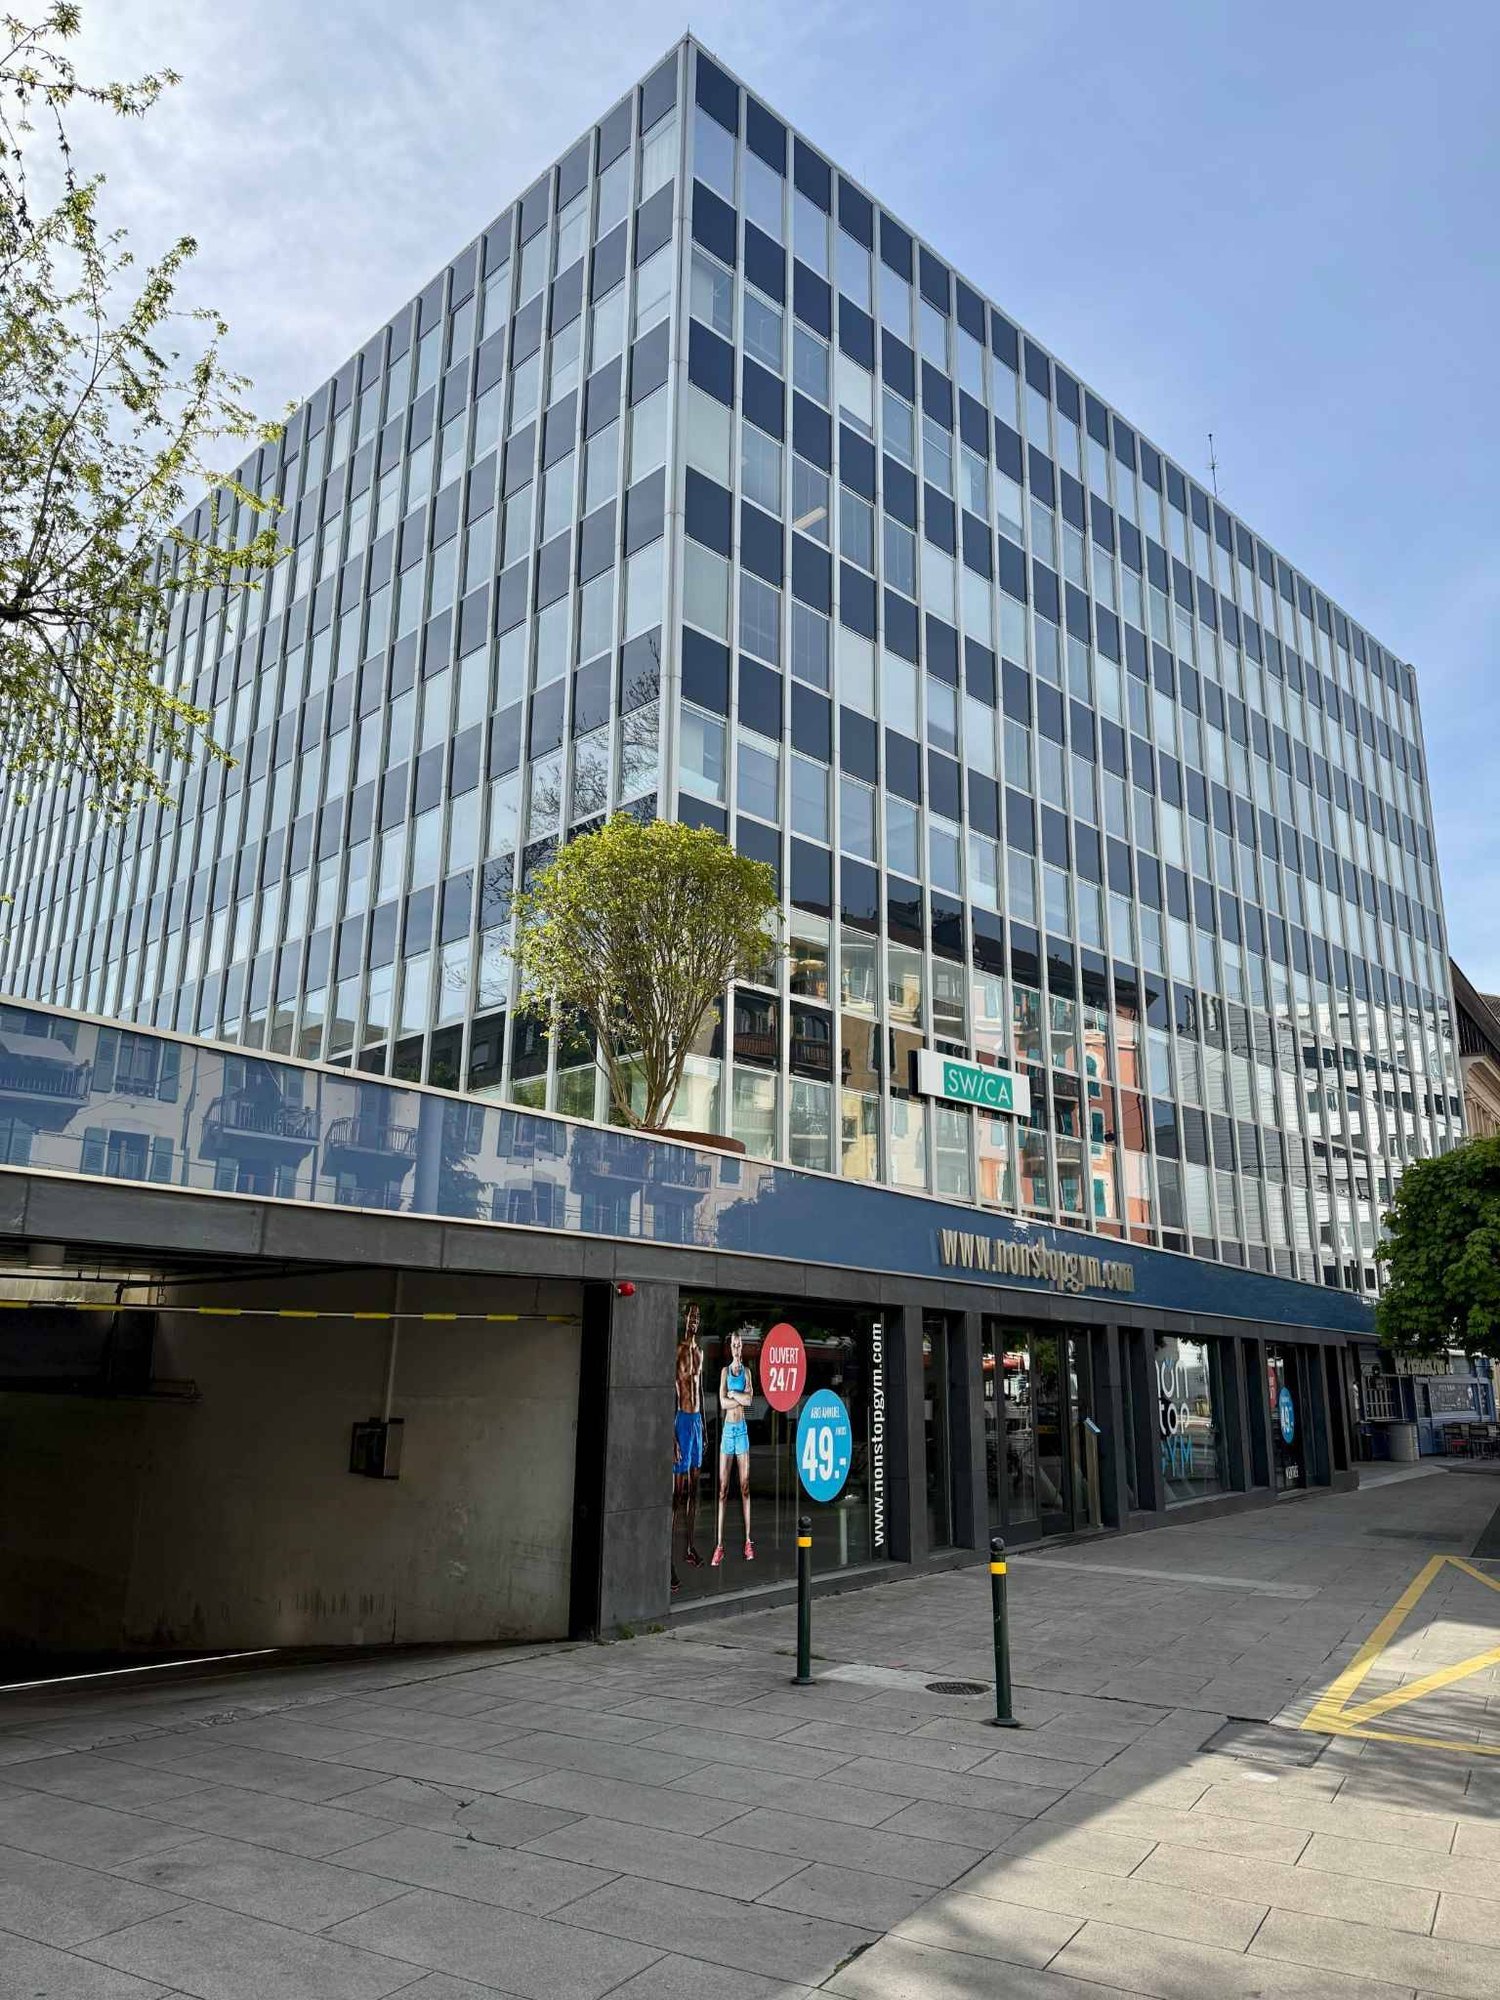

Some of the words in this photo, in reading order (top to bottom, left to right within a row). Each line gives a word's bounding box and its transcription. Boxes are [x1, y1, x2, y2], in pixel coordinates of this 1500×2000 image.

[941, 1228, 1135, 1293] www.nonstopgym.com
[769, 1347, 800, 1365] OUVERT
[769, 1367, 798, 1392] 24/7
[802, 1426, 847, 1482] 49.-
[871, 1322, 886, 1547] www.nonstopgym.com
